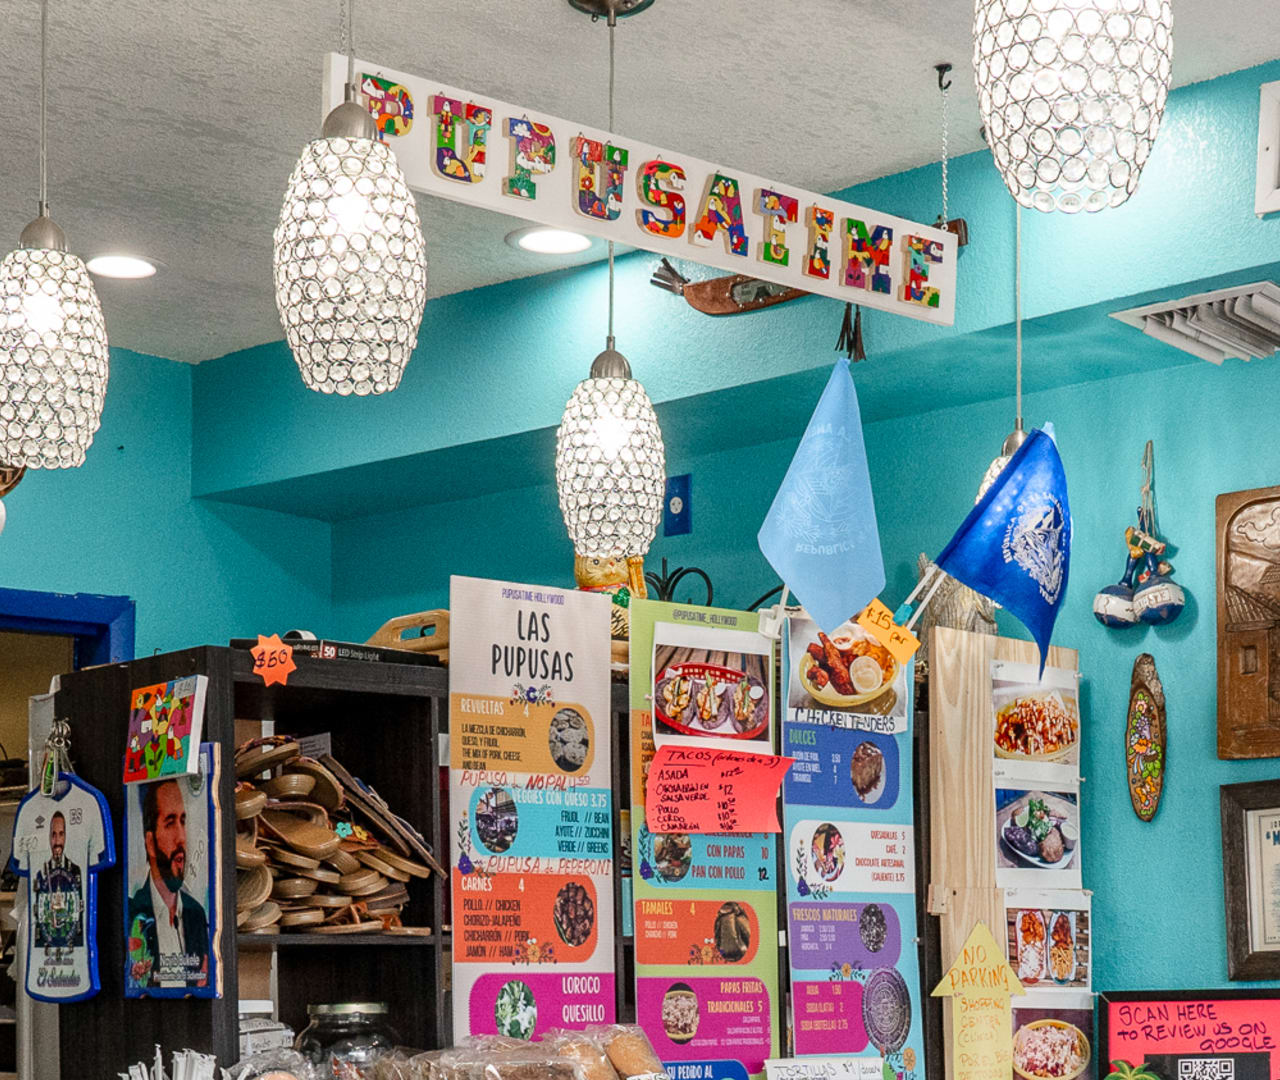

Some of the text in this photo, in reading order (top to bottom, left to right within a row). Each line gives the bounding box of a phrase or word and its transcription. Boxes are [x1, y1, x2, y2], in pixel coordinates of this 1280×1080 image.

[359, 71, 943, 309] PUPUSATIME
[517, 610, 550, 642] LAS
[323, 646, 336, 658] 50
[338, 648, 349, 657] LED
[350, 649, 363, 661] Strip
[364, 651, 380, 662] Light
[491, 644, 574, 682] PUPUSAS
[461, 698, 529, 717] REVUELTAS 4
[789, 729, 817, 746] DULCES
[667, 751, 712, 761] TACOS
[658, 768, 688, 780] ASADA
[525, 775, 567, 792] NOPAL
[546, 790, 562, 805] CON
[564, 791, 588, 807] QUESO
[590, 793, 607, 808] 3.75
[683, 792, 709, 801] VERDE
[70, 808, 83, 826] ES
[594, 811, 610, 824] BEAN
[555, 825, 573, 837] AYOTE
[557, 840, 576, 852] VERDE
[706, 845, 720, 858] CON
[723, 845, 745, 859] PAPAS
[486, 855, 611, 876] PUPUSA PEPERONI
[855, 858, 879, 867] CHOCOLATE
[691, 867, 769, 881] PAN CON POLLO 12
[461, 877, 524, 892] CARNES 4
[641, 901, 695, 915] TAMALES 4
[792, 908, 858, 921] FRESCOS NATURALES
[963, 944, 987, 966] NO
[562, 976, 600, 995] LOROCO
[949, 964, 1009, 992] PARKING
[720, 981, 763, 993] PAPAS FRITAS
[707, 1000, 763, 1014] TRADICIONALES 5
[1119, 1003, 1217, 1026] SCAN HERE
[1141, 1021, 1267, 1041] REVIEW ON
[678, 1065, 702, 1080] PEDIDO
[704, 1065, 713, 1079] AL
[774, 1063, 837, 1077] TORTILLAS
